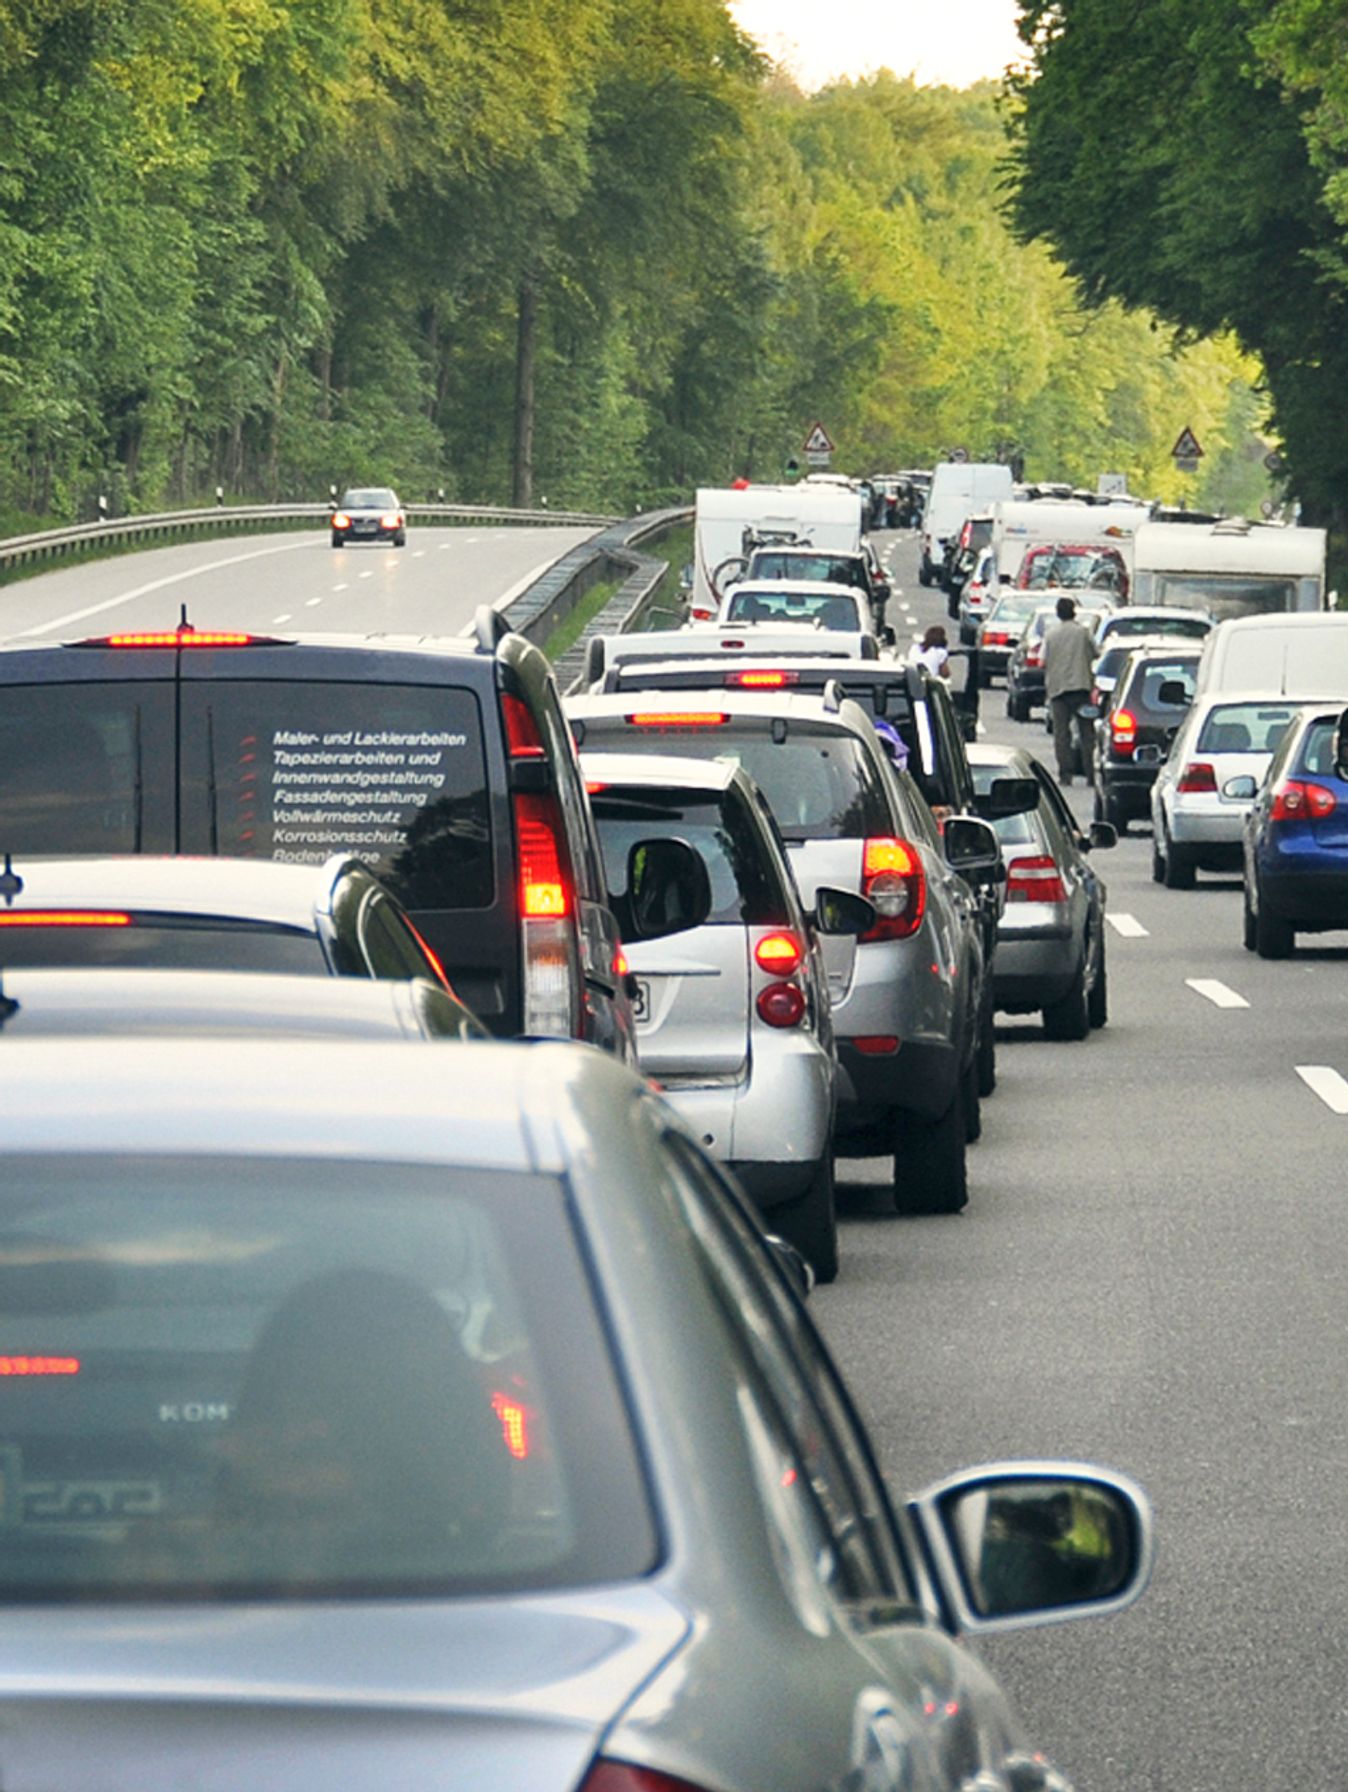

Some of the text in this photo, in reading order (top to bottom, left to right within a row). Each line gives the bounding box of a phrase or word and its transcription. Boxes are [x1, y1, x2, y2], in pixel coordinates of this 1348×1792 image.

[273, 731, 466, 746] Maler- und Lackierarbeiten
[273, 751, 441, 767] Tapezierarbeiten und
[272, 770, 446, 788] Innenwandgestaltung
[273, 789, 428, 807] Fassadengestaltung
[273, 809, 401, 823] Vollwärmeschutz
[272, 828, 408, 843] Korrosionsschutz
